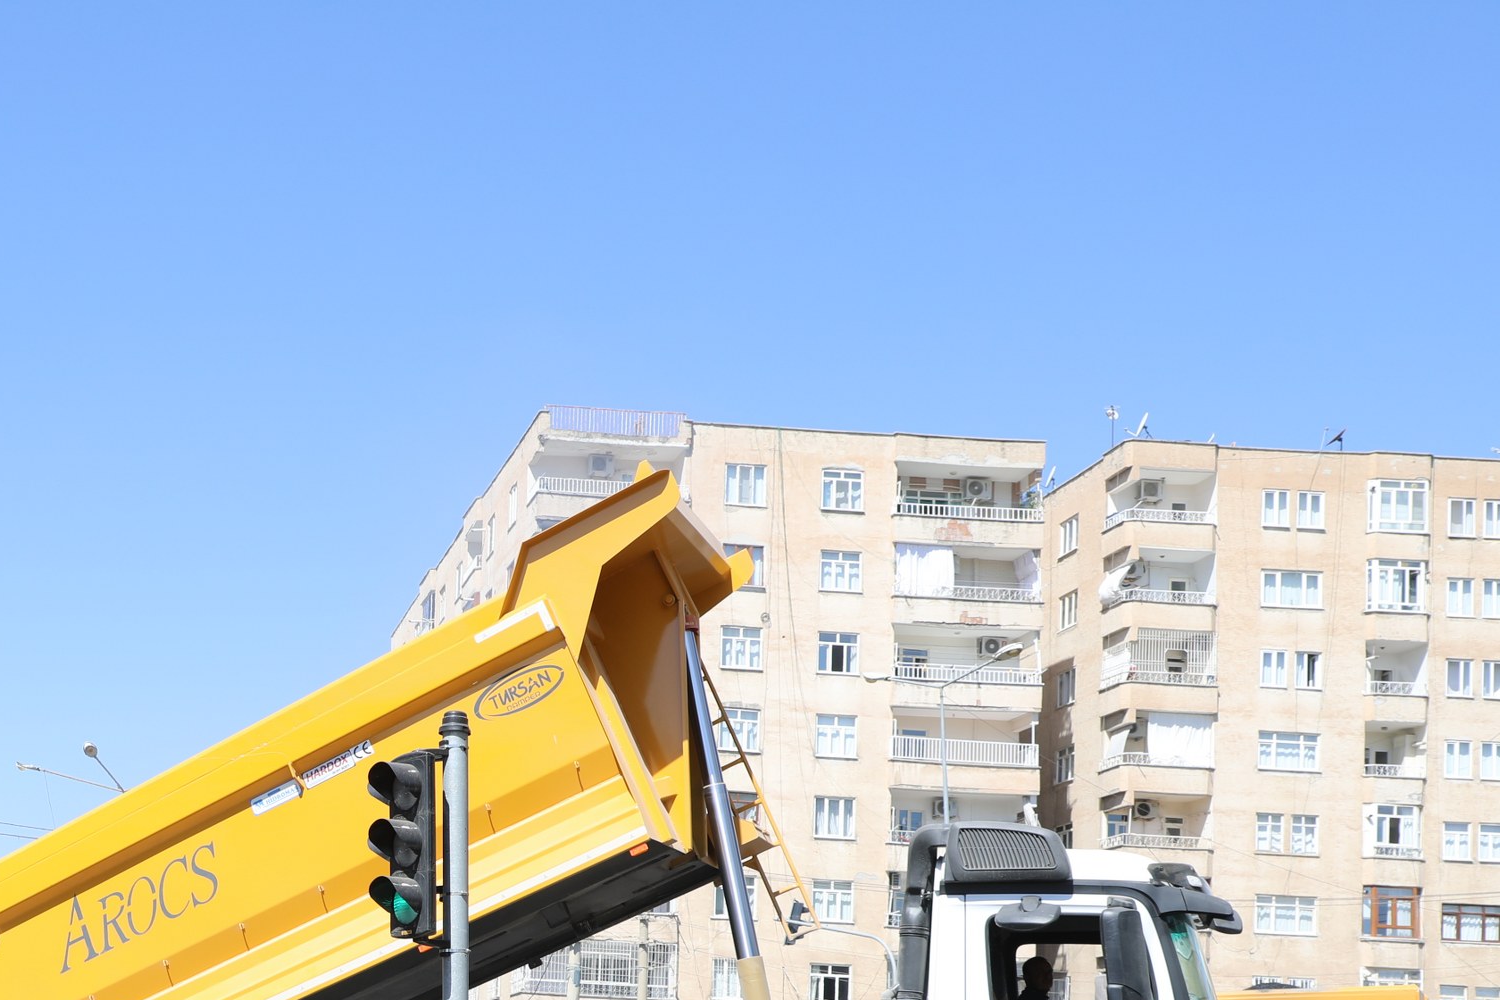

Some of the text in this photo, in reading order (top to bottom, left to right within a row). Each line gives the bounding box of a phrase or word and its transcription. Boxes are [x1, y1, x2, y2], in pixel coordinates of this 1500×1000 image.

[488, 669, 552, 710] TURSAN
[305, 754, 350, 783] HARDOX
[60, 840, 219, 975] AROCS
